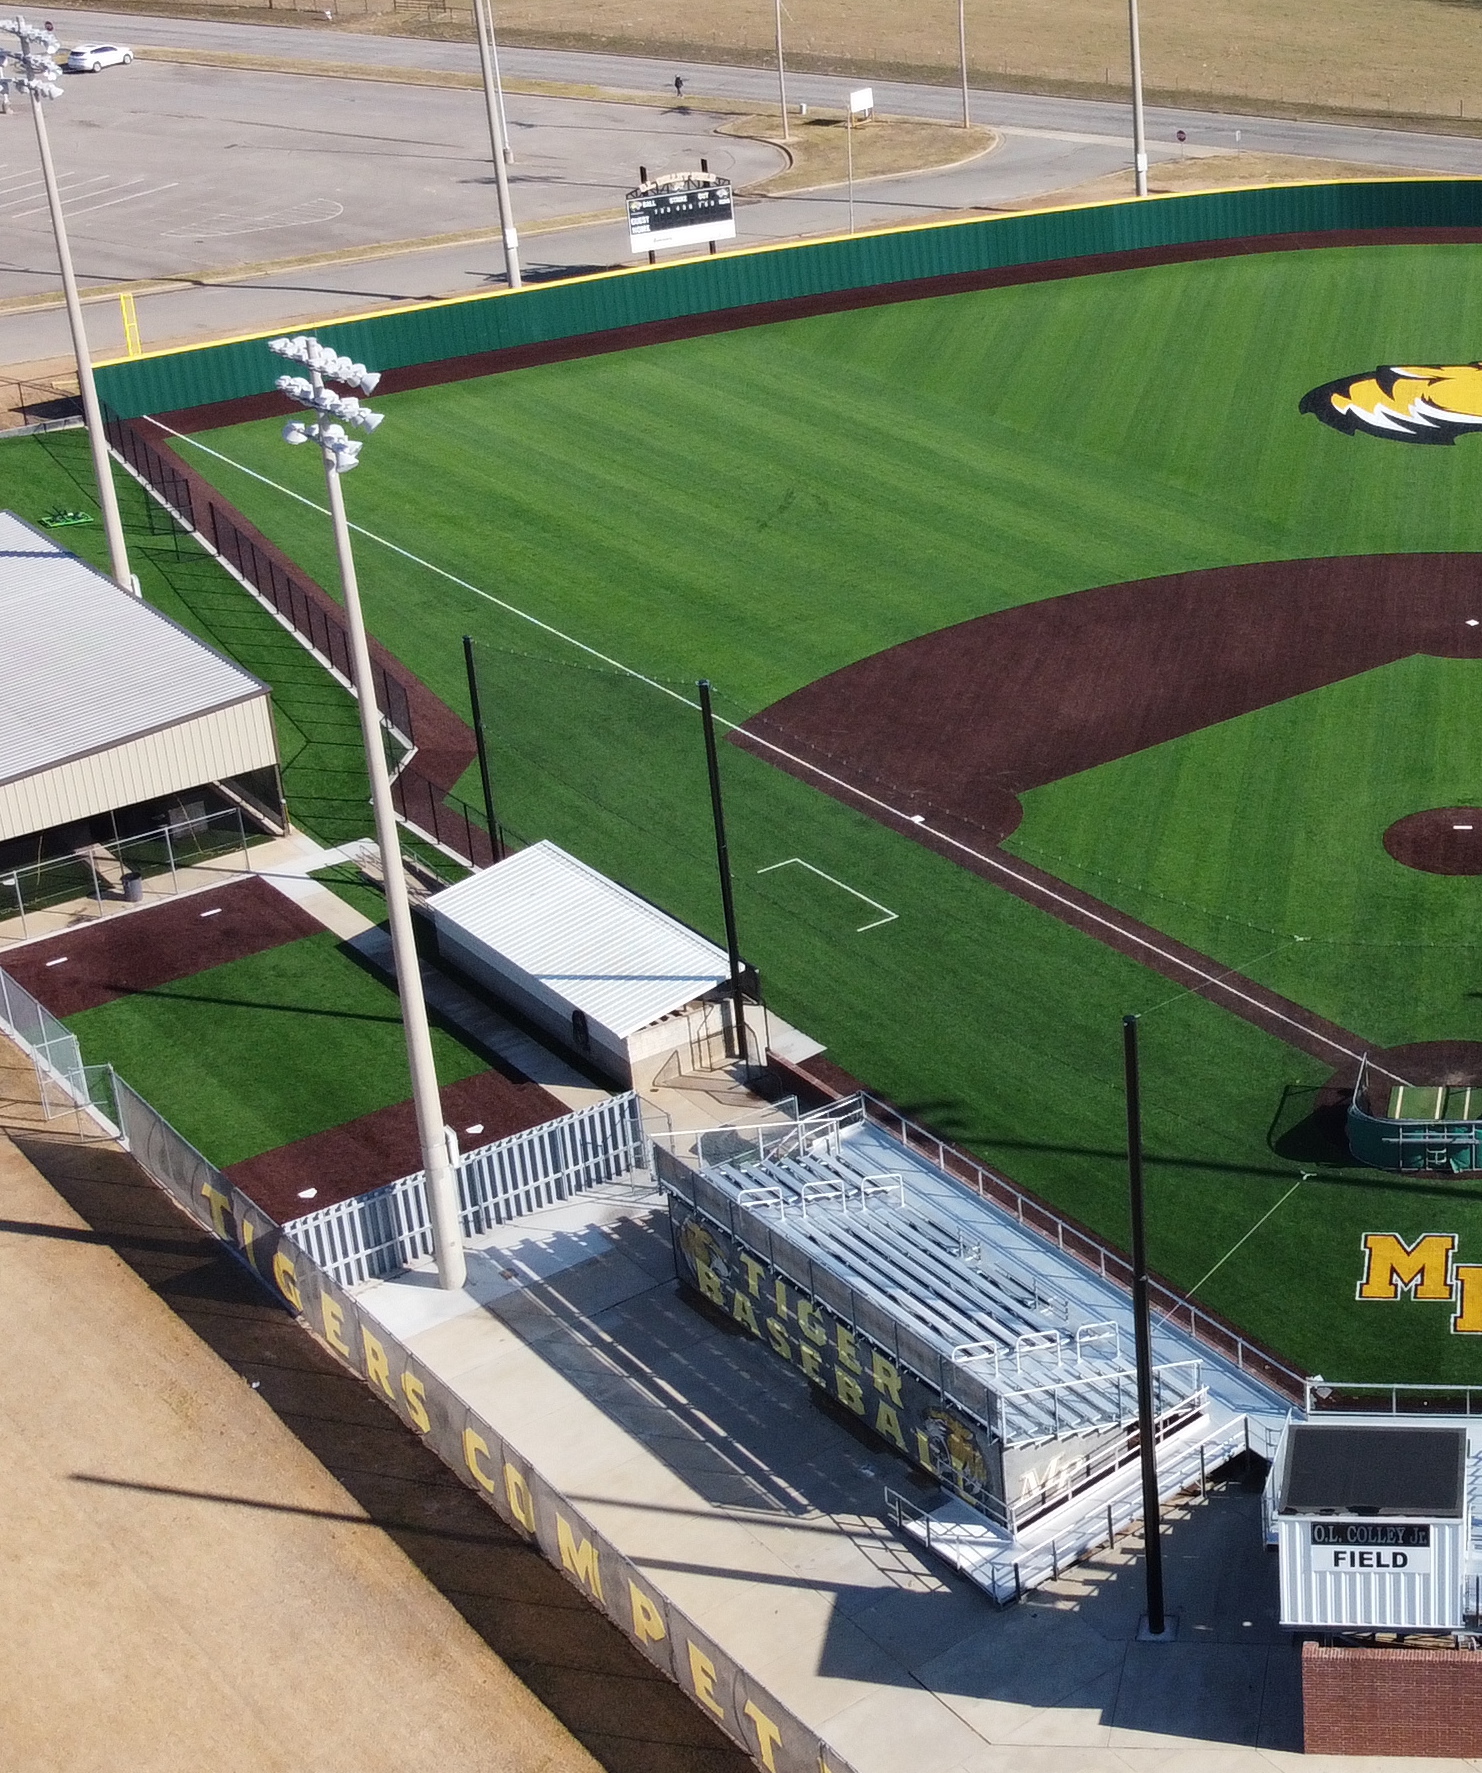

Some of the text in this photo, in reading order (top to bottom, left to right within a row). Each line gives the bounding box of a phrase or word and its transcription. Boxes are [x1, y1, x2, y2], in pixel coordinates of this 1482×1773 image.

[200, 1183, 431, 1434] TIGERS
[698, 1265, 980, 1507] BASEBALL
[740, 1253, 905, 1410] TIGER
[461, 1427, 832, 1773] COMPET
[1313, 1525, 1342, 1543] O.L.
[1346, 1526, 1406, 1544] COLLEY
[1333, 1550, 1409, 1569] FIELD
